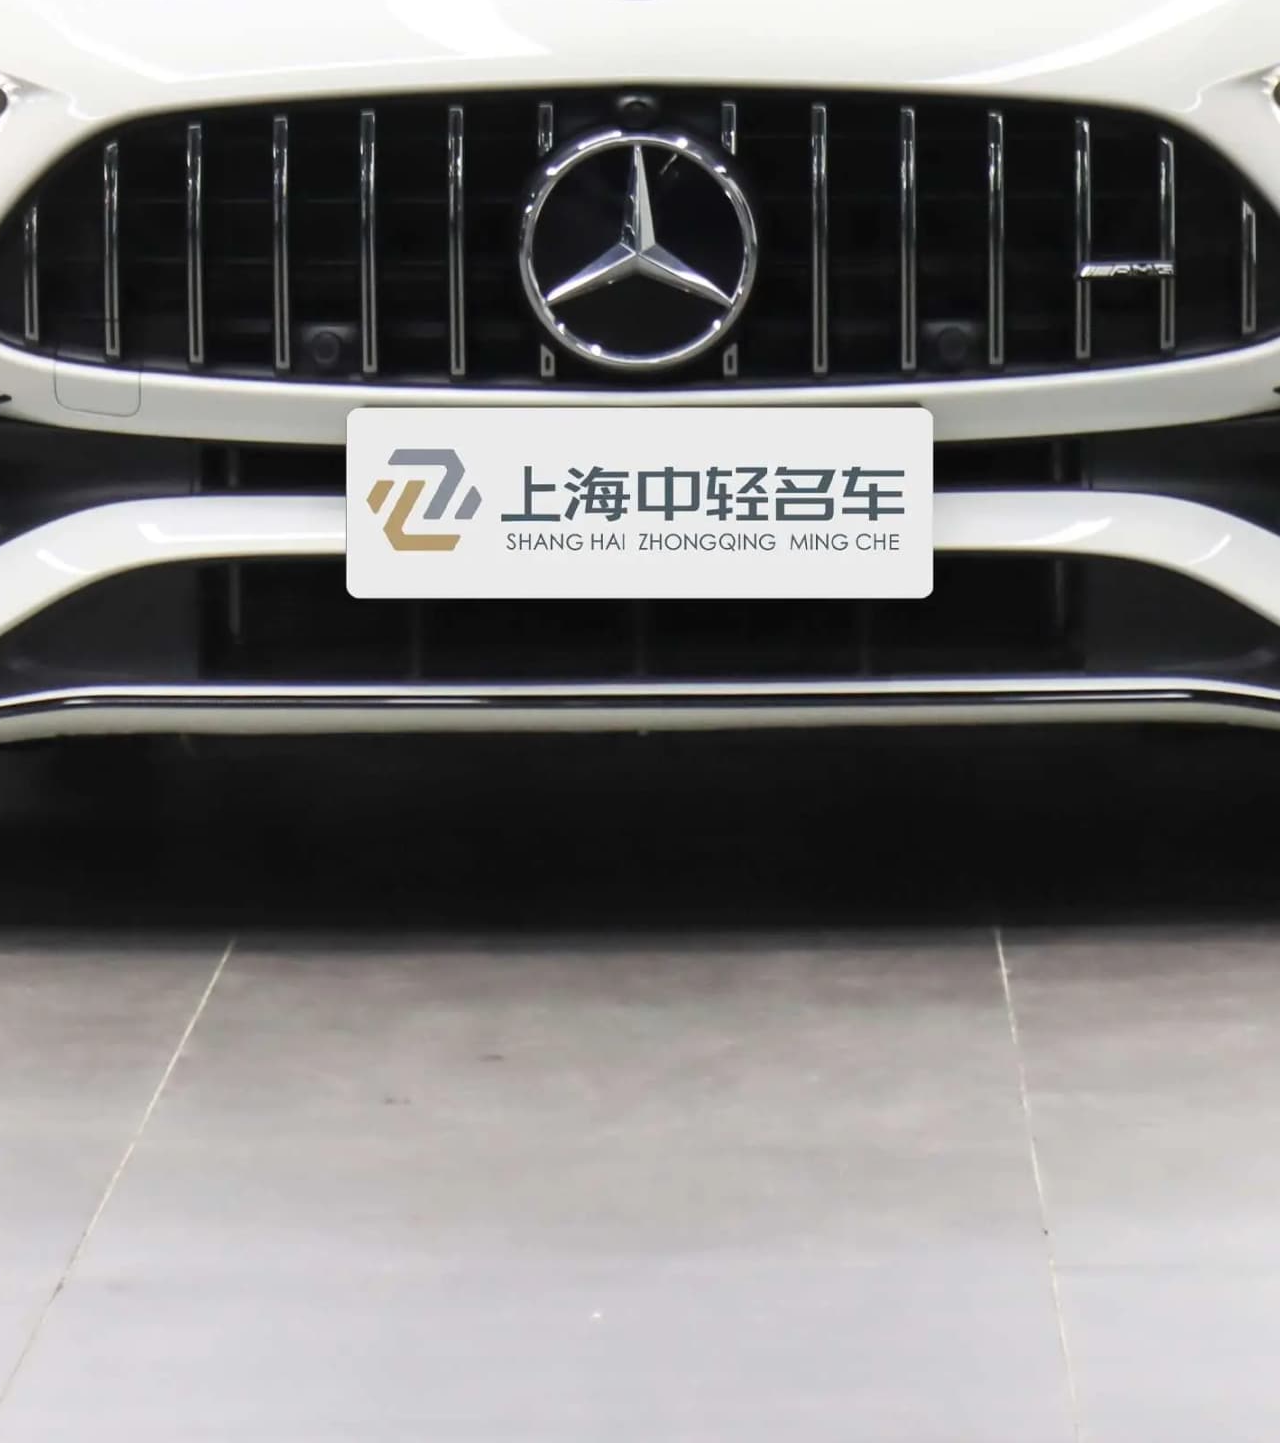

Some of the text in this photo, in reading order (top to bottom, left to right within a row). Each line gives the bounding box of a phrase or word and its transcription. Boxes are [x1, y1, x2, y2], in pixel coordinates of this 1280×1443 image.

[500, 465, 906, 523] 上海中轻名车
[506, 532, 900, 552] SHANG HAI ZHONGQING MING CHE
